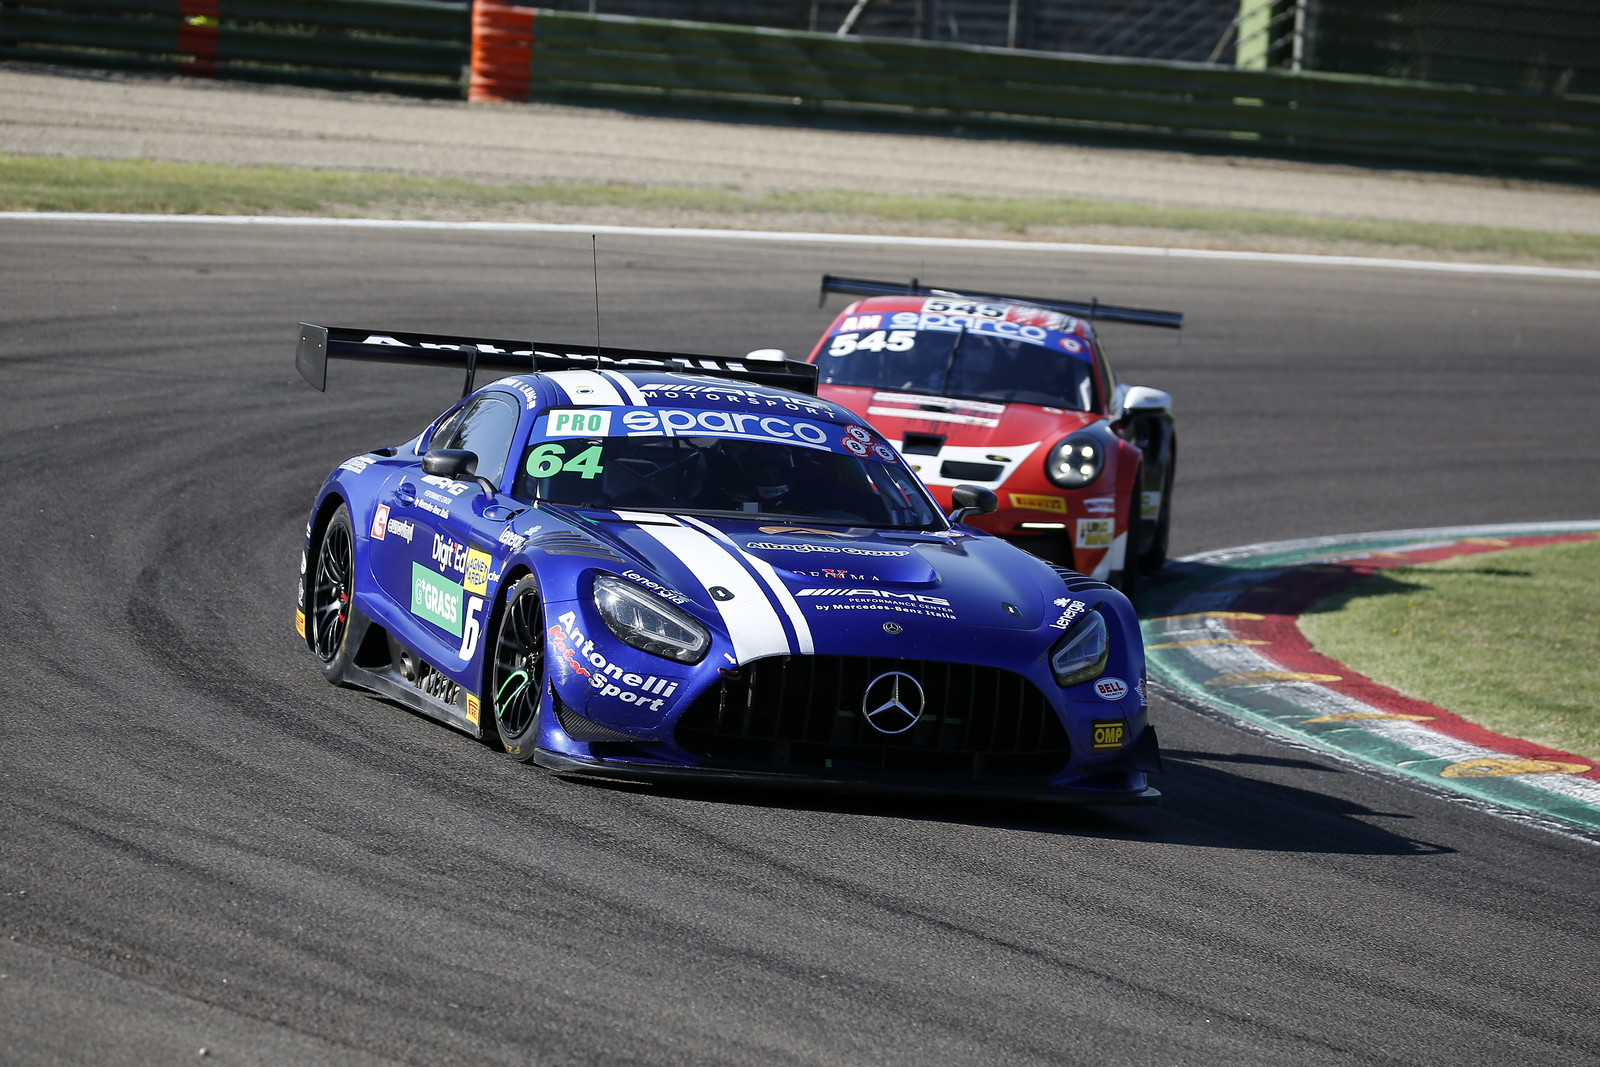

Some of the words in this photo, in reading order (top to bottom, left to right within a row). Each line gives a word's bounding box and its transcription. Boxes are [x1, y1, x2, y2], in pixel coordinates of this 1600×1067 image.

[889, 311, 1048, 342] sparco
[828, 330, 917, 358] 545
[641, 390, 836, 419] MOTORSPORT
[555, 413, 602, 432] PRO
[622, 409, 829, 446] sparco
[525, 443, 605, 480] 64
[424, 582, 458, 624] GRASS
[832, 603, 923, 615] Mercedes-Benz
[926, 610, 957, 620] Italia
[849, 597, 907, 608] PERFORMANCE
[908, 603, 954, 613] CENTER
[548, 625, 591, 678] Motor
[589, 672, 665, 712] sport
[558, 611, 679, 698] Antonelli
[1097, 682, 1124, 694] BELL
[1094, 726, 1123, 744] OMP
